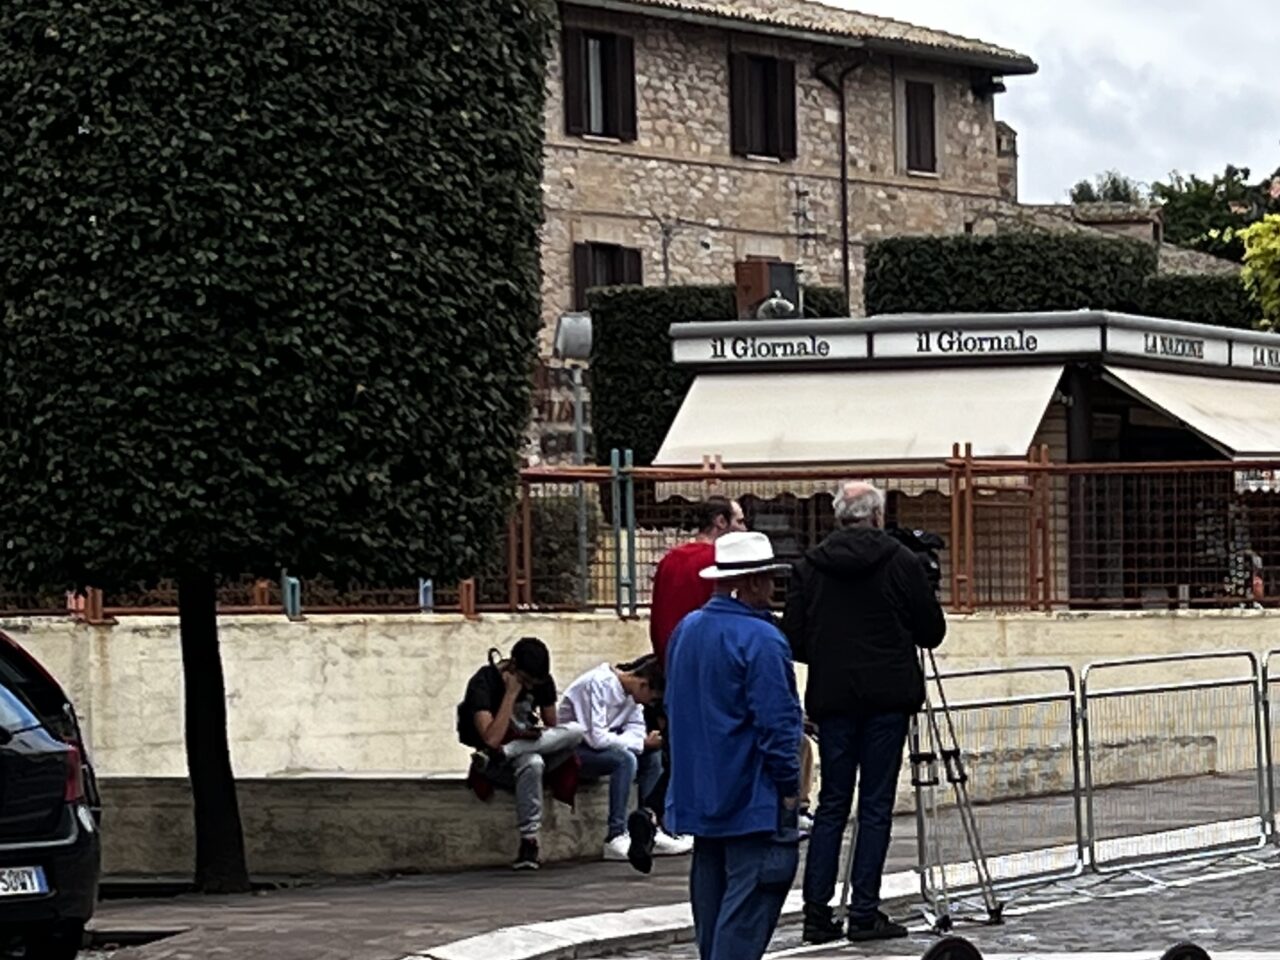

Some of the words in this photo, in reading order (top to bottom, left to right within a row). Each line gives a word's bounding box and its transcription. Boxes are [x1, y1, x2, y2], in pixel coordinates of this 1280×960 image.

[711, 336, 727, 359] il
[731, 334, 831, 359] Giornale
[916, 329, 932, 353] il
[937, 328, 1038, 353] Giornale
[1143, 333, 1158, 354] LA
[1159, 335, 1204, 360] NAZIONE
[1253, 345, 1266, 367] LA
